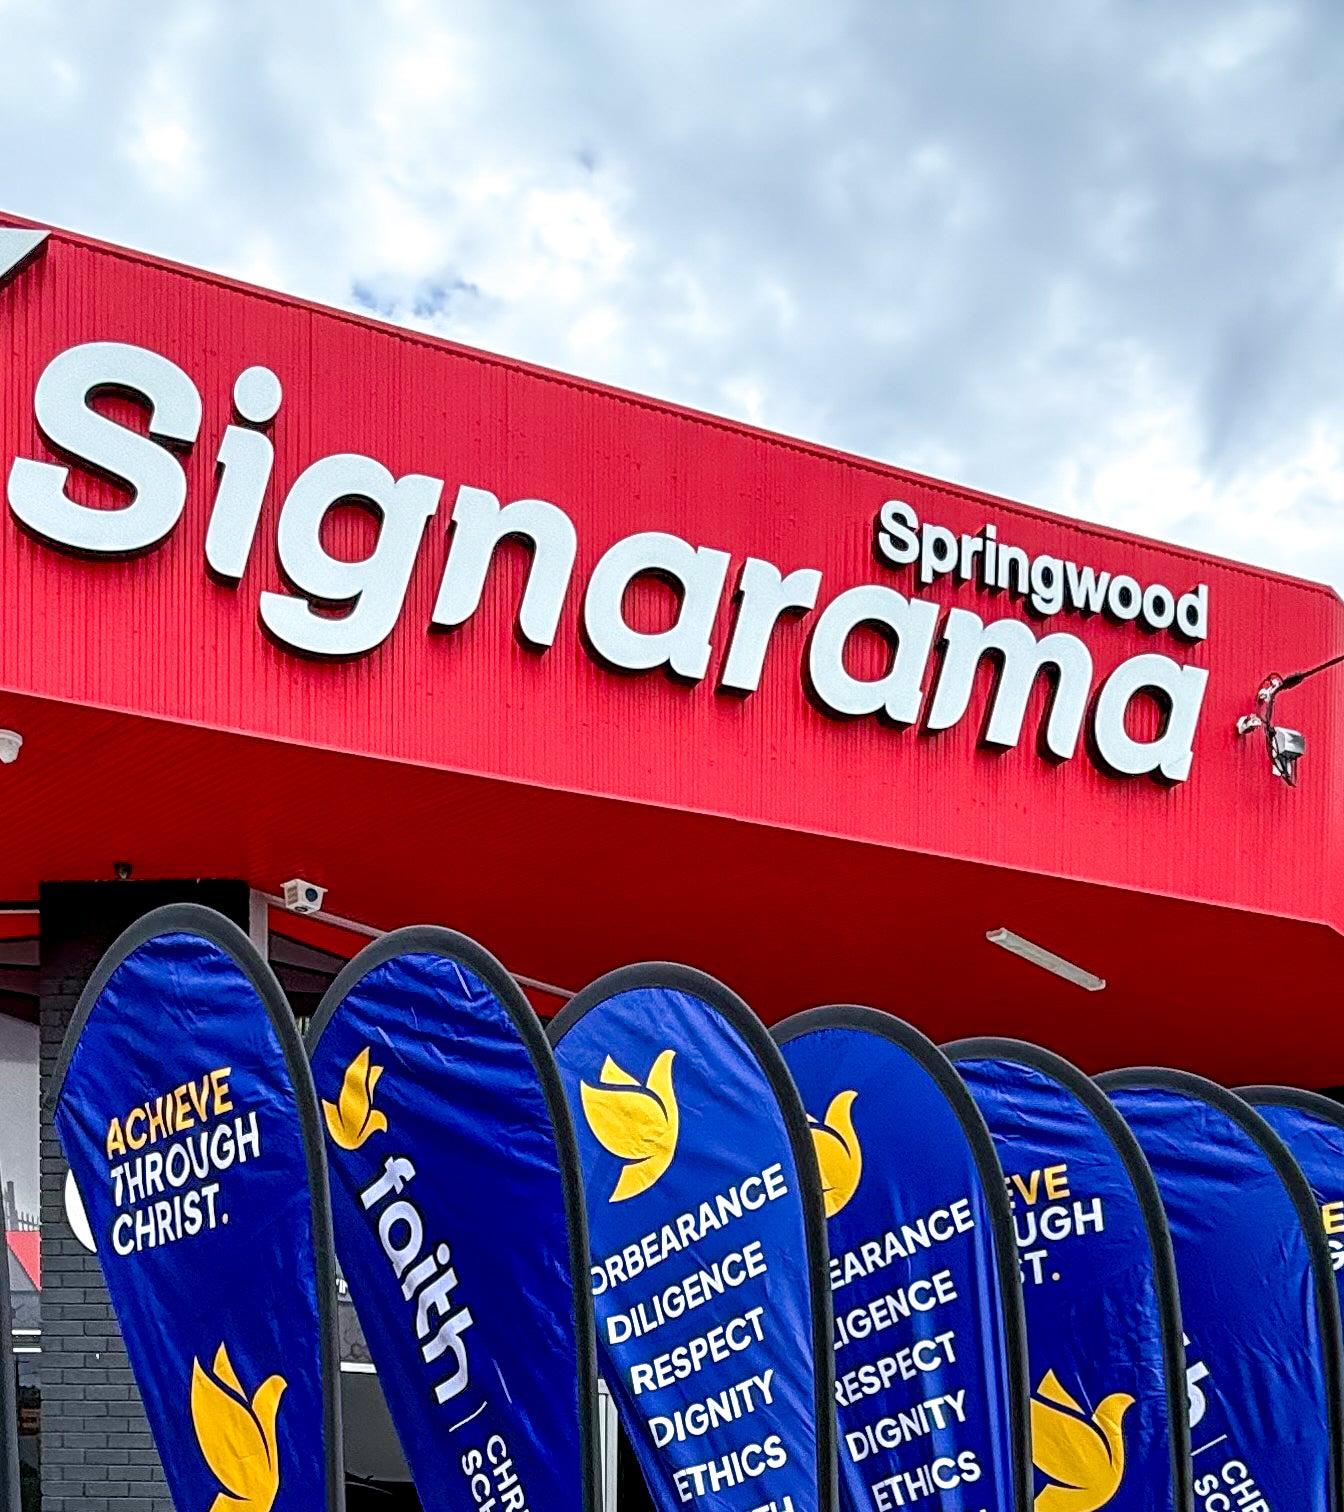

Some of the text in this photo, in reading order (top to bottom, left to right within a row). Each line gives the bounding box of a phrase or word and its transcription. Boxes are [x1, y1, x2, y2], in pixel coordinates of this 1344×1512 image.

[7, 340, 1209, 785] Signarama
[878, 500, 1208, 640] Springwood
[107, 1067, 233, 1159] ACHIEVE
[110, 1112, 260, 1207] THROUGH
[112, 1183, 229, 1255] CHRIST.
[360, 1157, 473, 1404] faith
[607, 1241, 767, 1345] DILIGENCE
[630, 1307, 765, 1394] RESPECT
[648, 1369, 774, 1448] DIGNITY
[846, 1390, 966, 1463] DIGNITY
[673, 1435, 787, 1502] ETHICS
[871, 1451, 981, 1512] ETHICS
